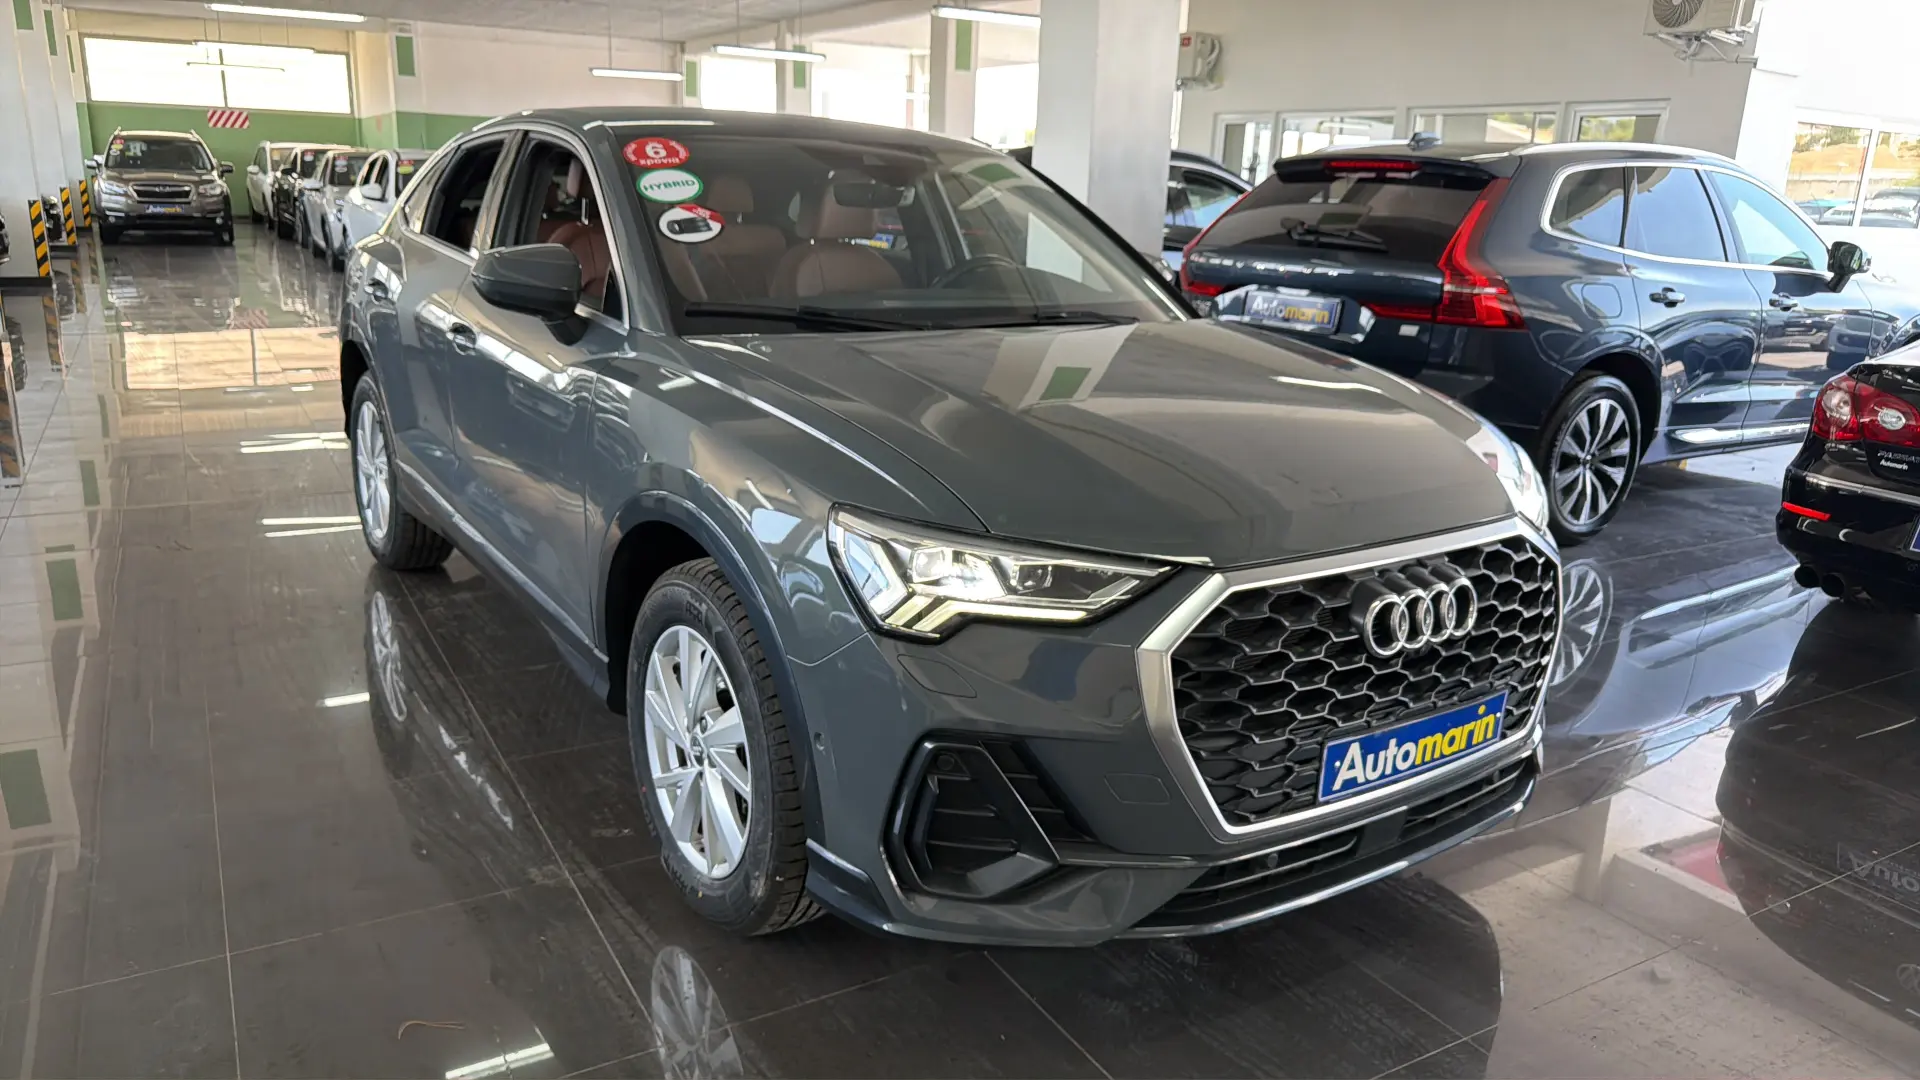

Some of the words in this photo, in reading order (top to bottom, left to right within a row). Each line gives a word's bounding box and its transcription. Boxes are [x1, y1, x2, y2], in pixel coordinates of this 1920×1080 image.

[645, 141, 667, 159] 6
[643, 179, 696, 192] HYBRID
[1251, 295, 1330, 324] Automarin
[1332, 704, 1496, 791] Automarin
